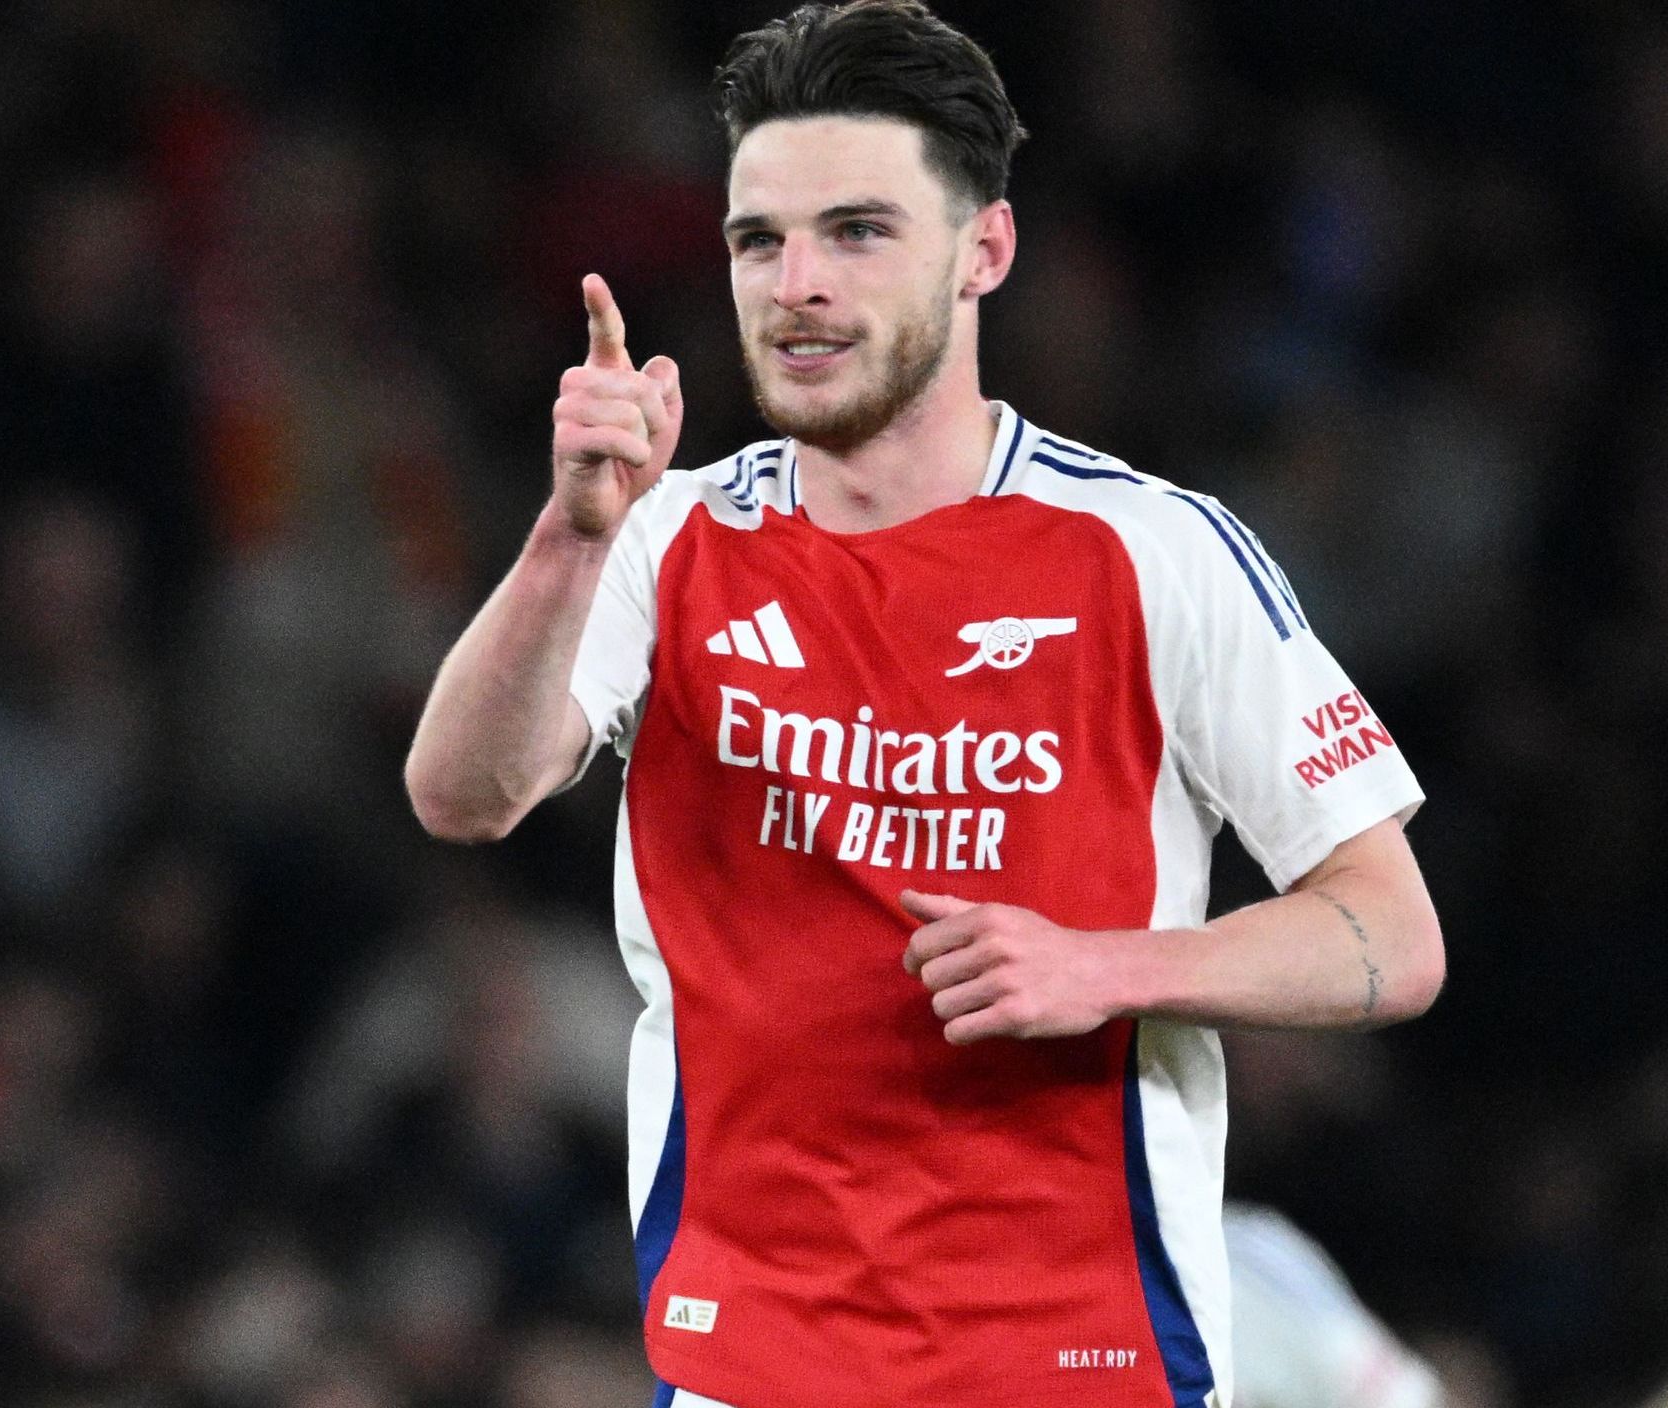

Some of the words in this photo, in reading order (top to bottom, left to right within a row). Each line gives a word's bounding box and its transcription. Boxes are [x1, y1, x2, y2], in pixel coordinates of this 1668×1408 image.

[718, 685, 1062, 794] Emirates
[758, 786, 831, 854] FLY
[837, 802, 1005, 870] BETTER
[1058, 1350, 1137, 1368] HEAT.RDY
